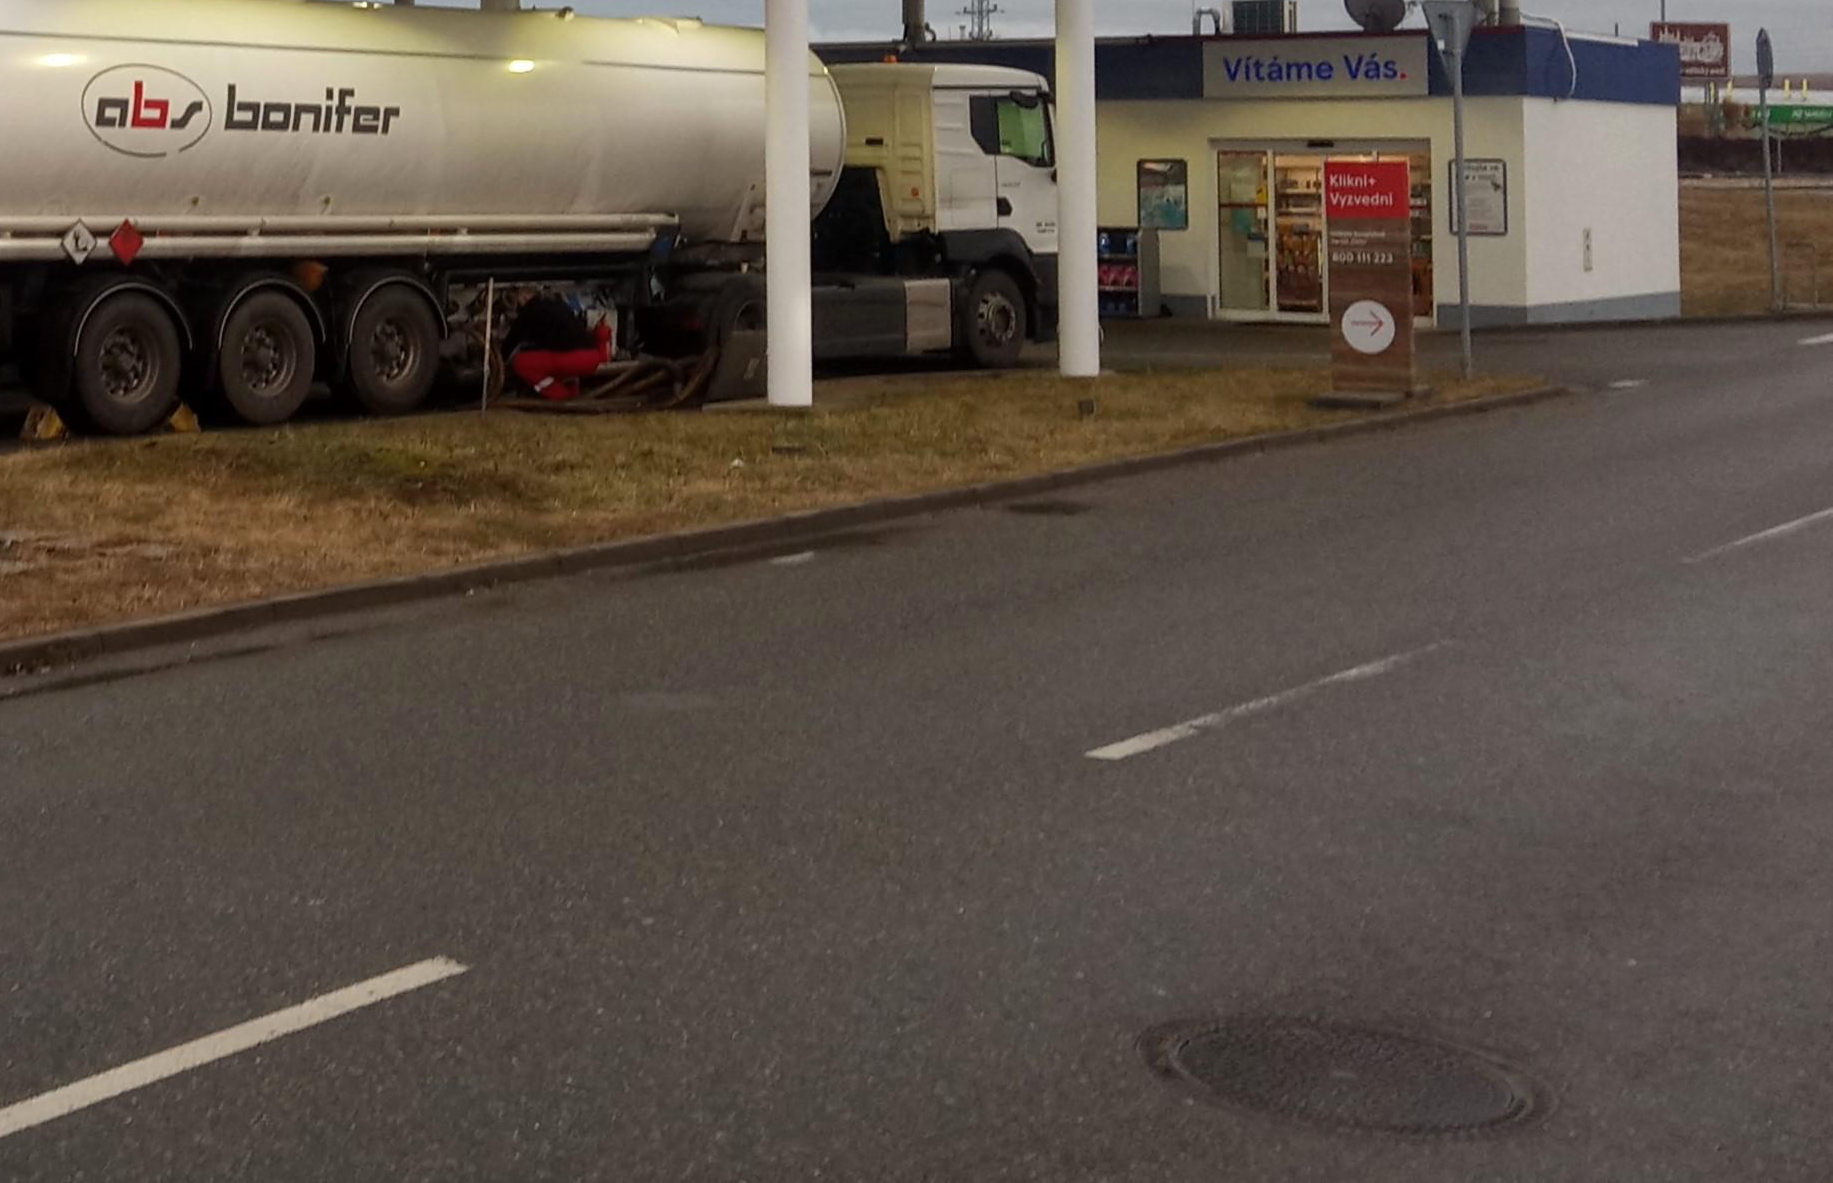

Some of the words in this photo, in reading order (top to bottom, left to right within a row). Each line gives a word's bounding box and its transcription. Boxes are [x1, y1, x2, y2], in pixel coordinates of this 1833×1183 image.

[1223, 55, 1335, 82] Vítáme
[1343, 52, 1407, 81] Vás.
[95, 80, 203, 129] abs
[224, 83, 400, 135] bonifer
[1329, 192, 1393, 209] Vyzvedni
